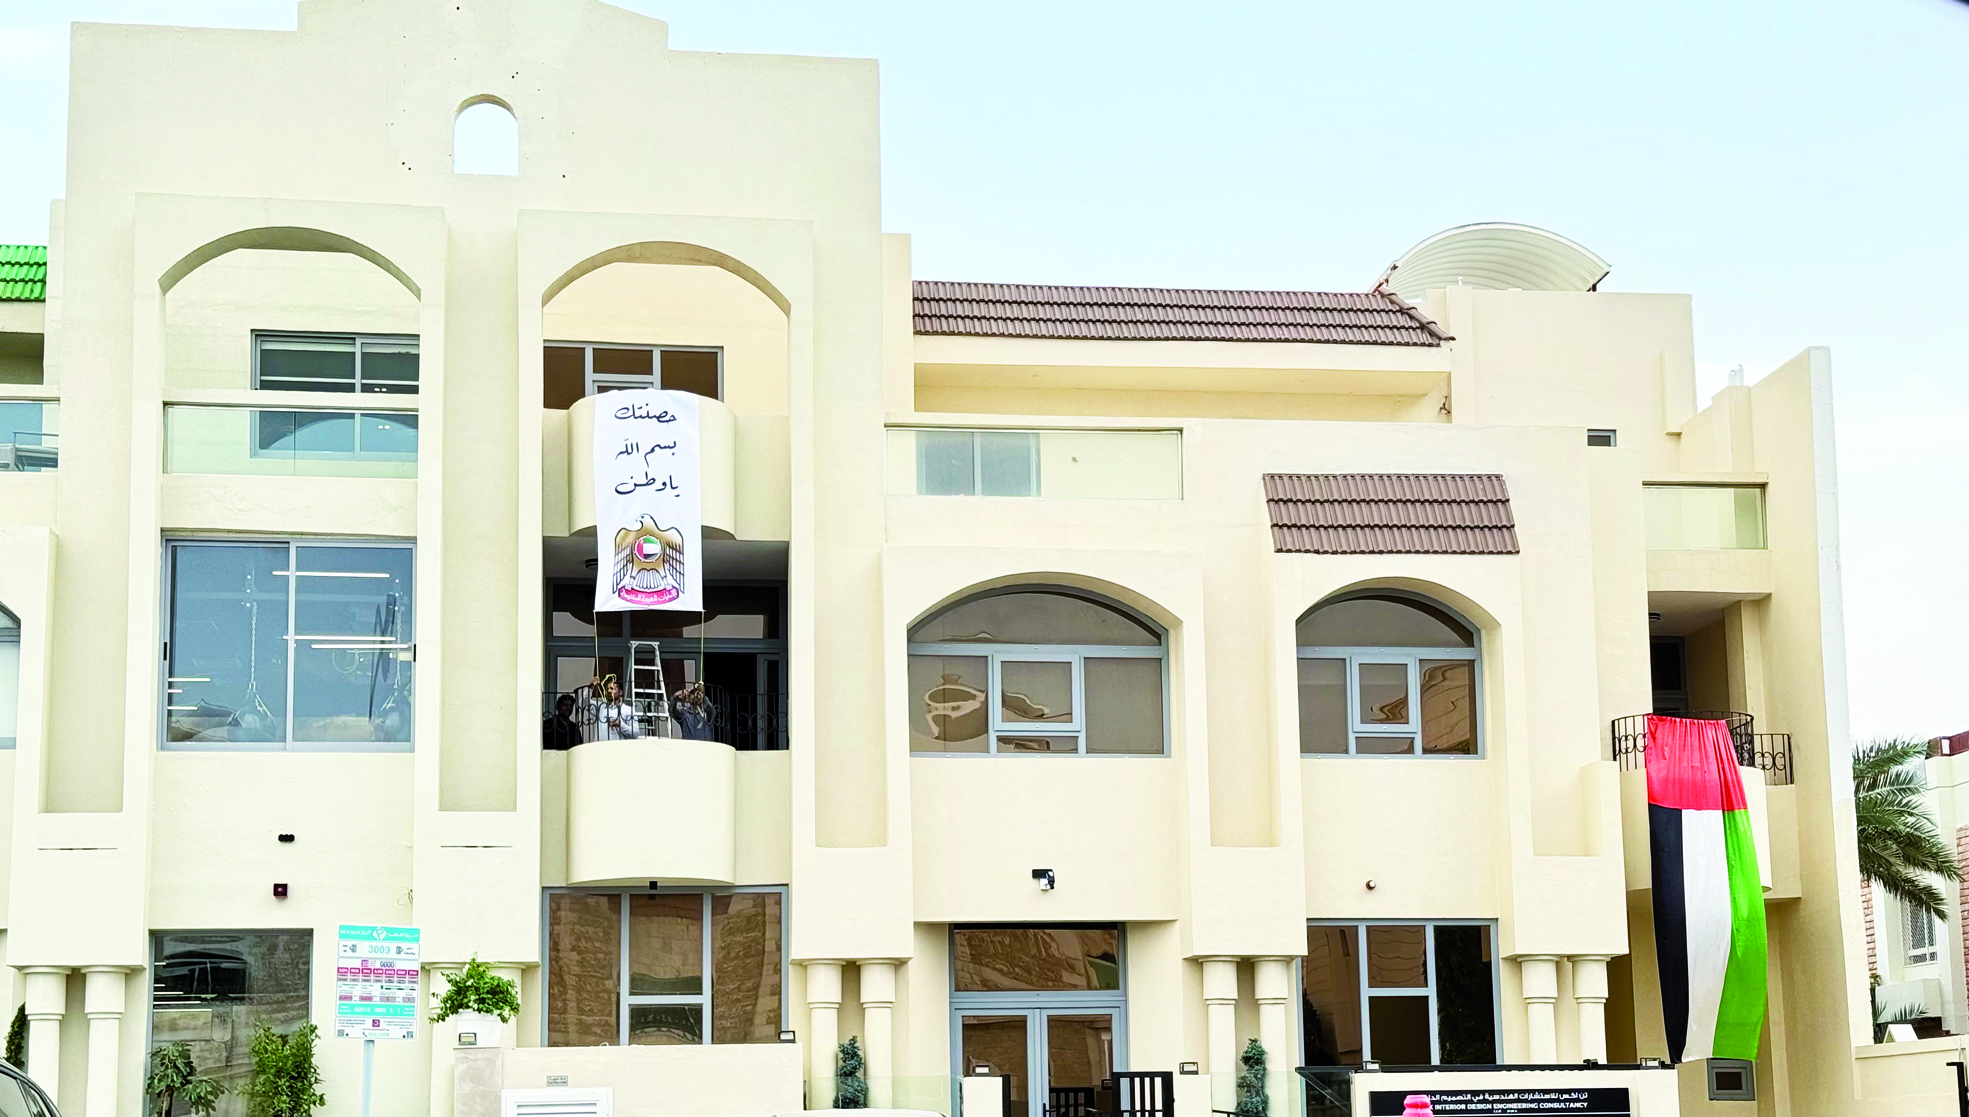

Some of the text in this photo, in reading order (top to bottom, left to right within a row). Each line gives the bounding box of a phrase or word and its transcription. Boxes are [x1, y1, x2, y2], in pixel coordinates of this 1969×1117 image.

[614, 402, 677, 425] حصنتك
[644, 440, 677, 468] بسم
[1472, 1094, 1484, 1102] في
[1484, 1092, 1518, 1101] الهندسية
[1539, 1101, 1588, 1109] CONSULTANCY
